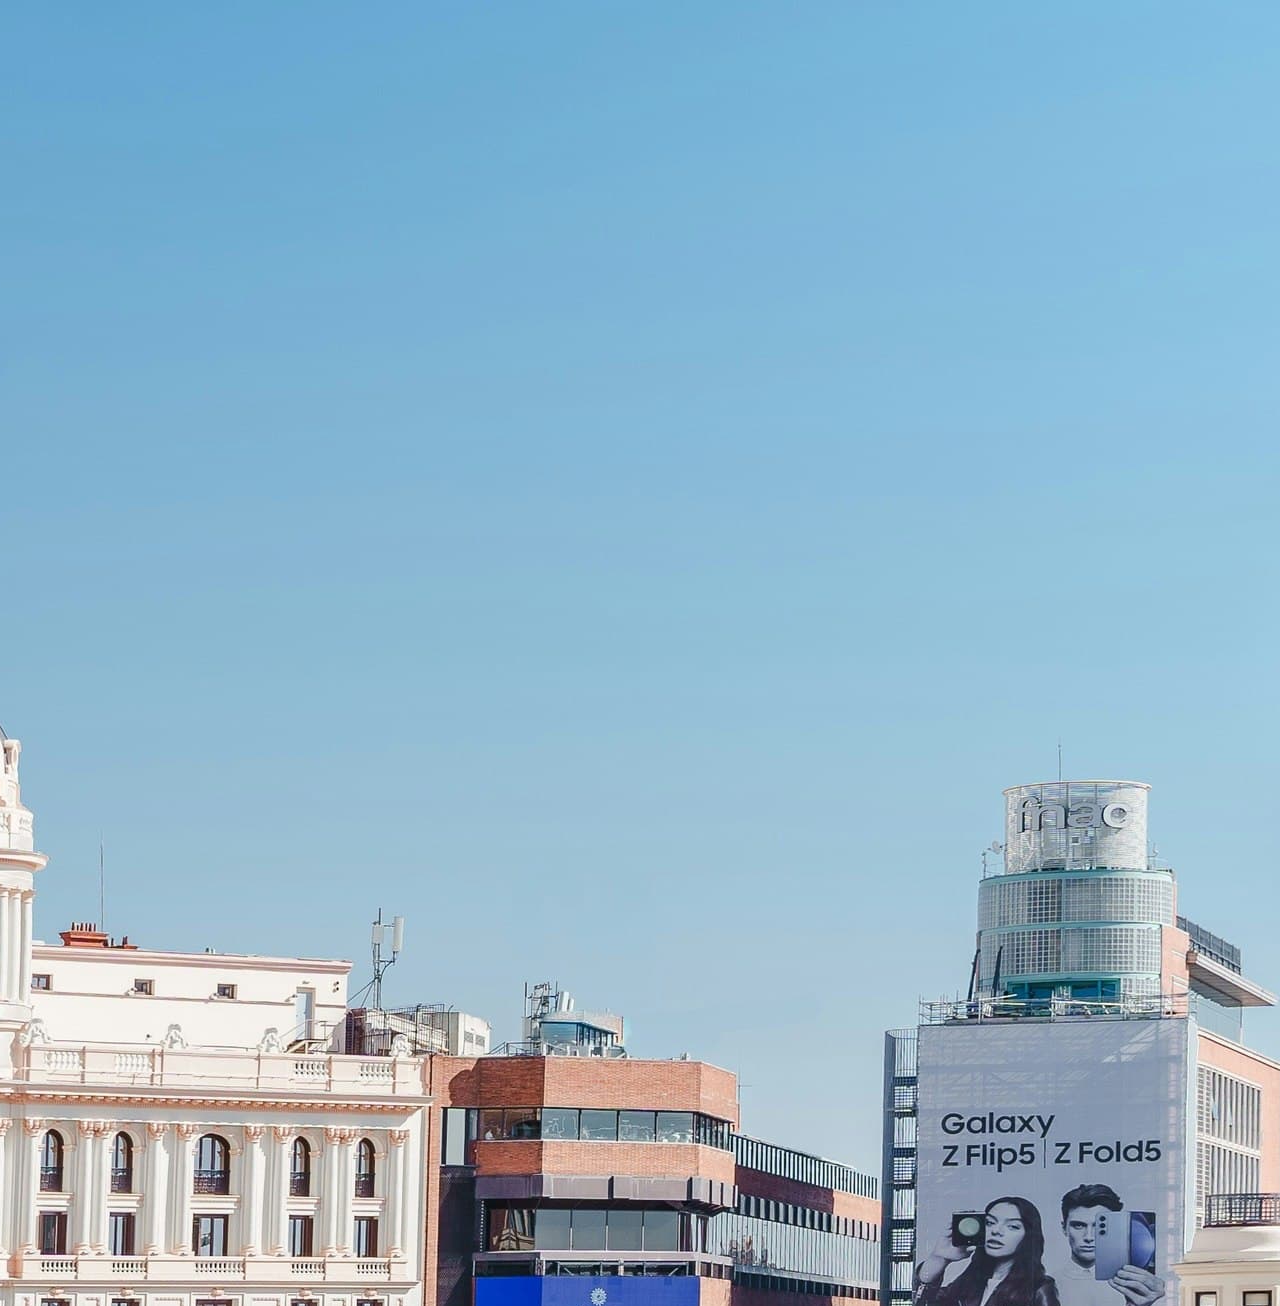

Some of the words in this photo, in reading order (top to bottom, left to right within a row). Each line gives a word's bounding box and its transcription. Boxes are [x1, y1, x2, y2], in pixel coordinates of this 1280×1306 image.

[941, 1112, 1055, 1138] Galaxy
[942, 1145, 959, 1166] Z
[966, 1142, 1035, 1173] Flip5
[1054, 1143, 1071, 1164] Z
[1078, 1140, 1161, 1164] Fold5
